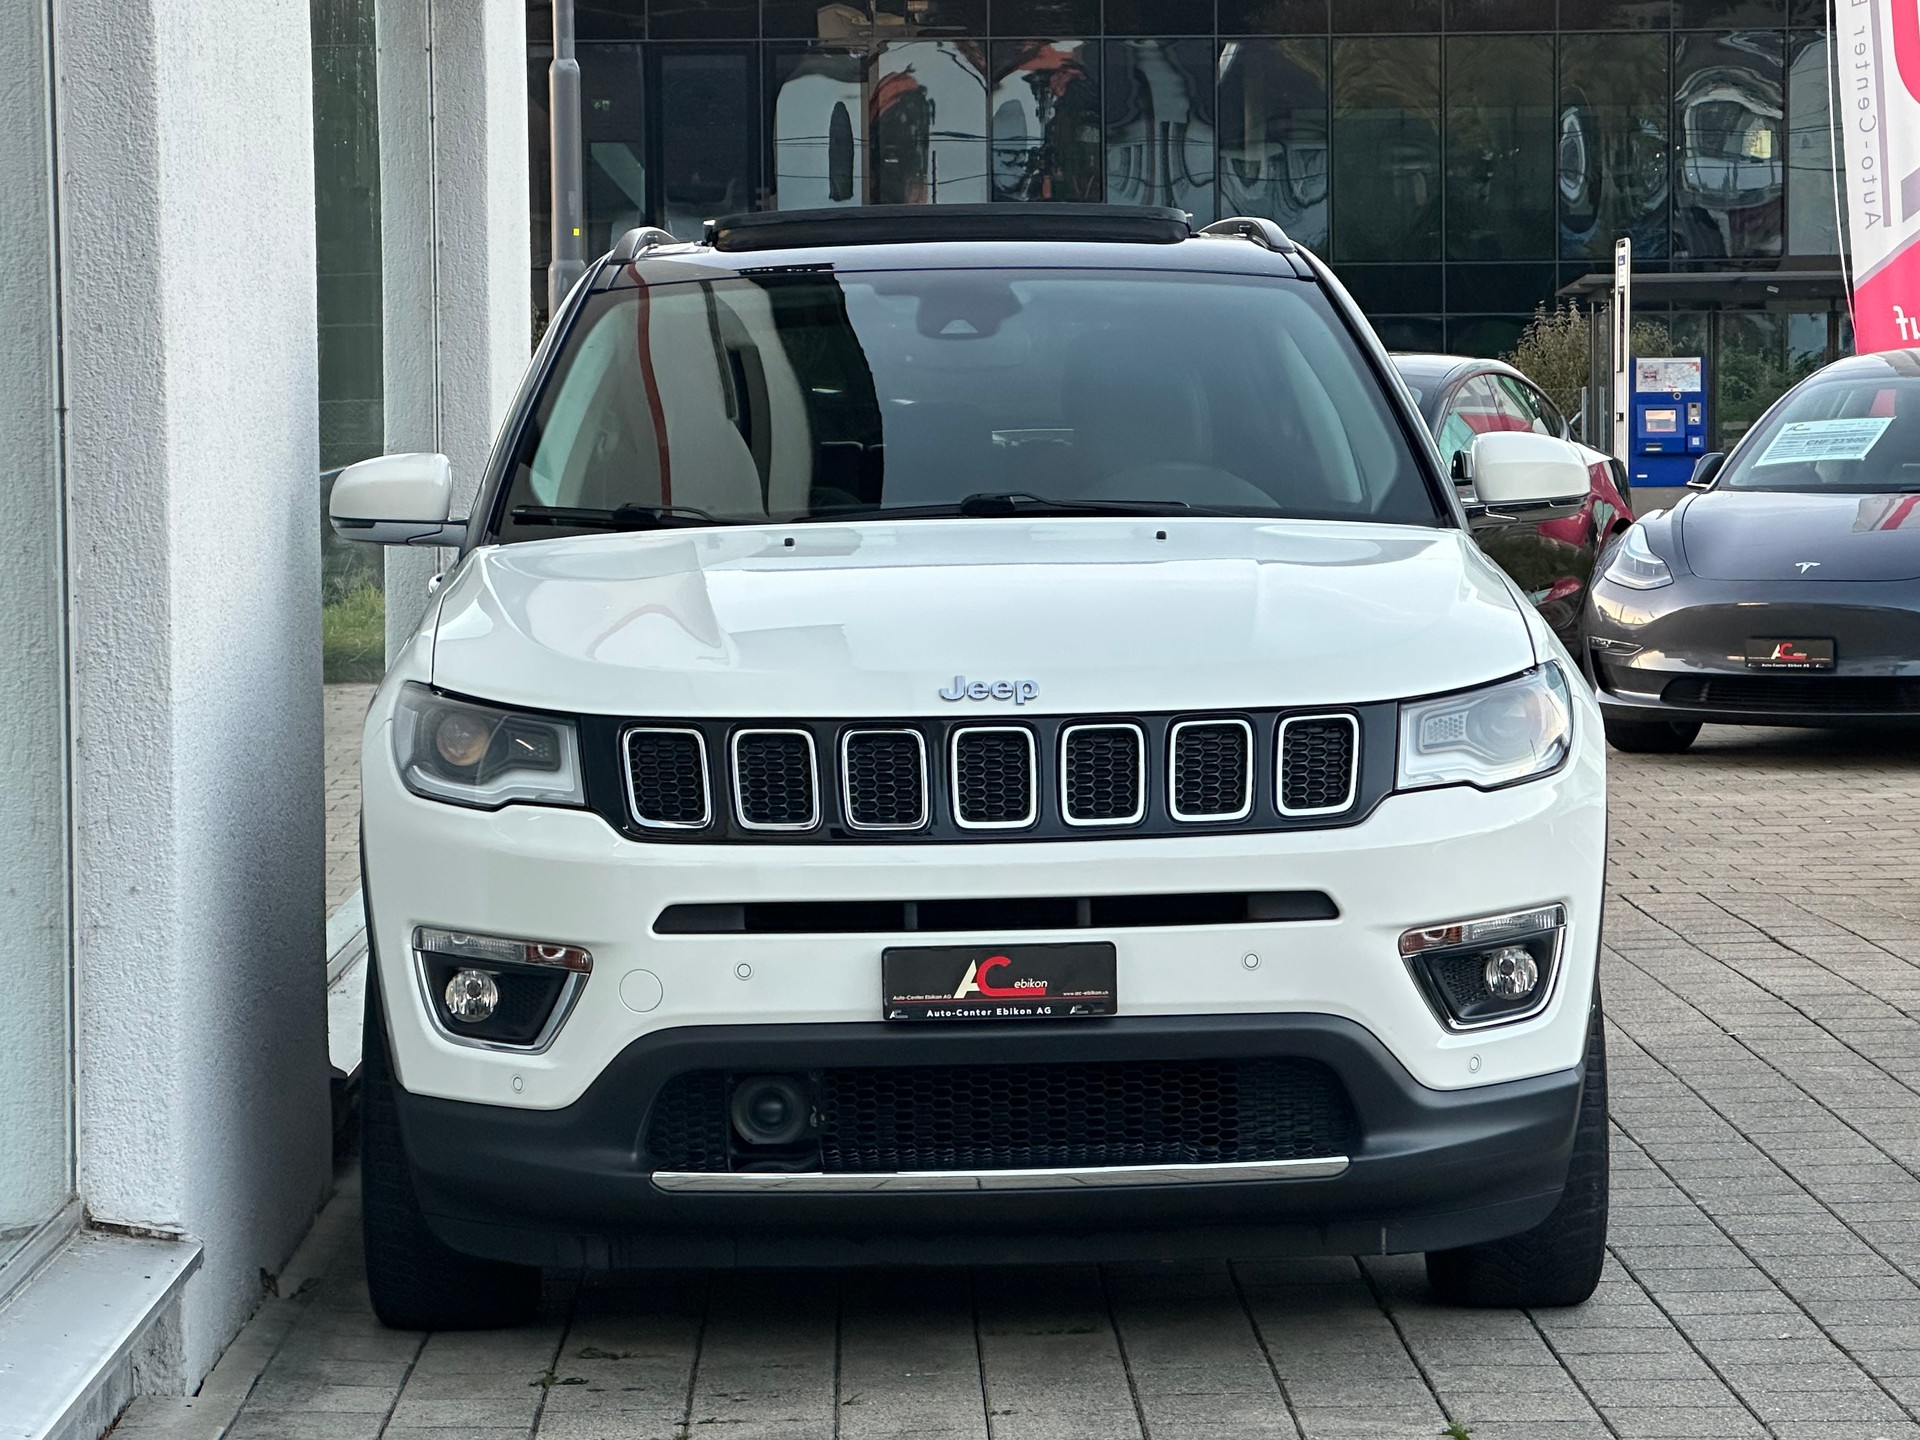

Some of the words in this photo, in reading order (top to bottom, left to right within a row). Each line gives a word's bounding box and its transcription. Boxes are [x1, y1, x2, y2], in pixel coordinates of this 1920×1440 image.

[939, 675, 1040, 705] Jeep
[953, 955, 1046, 998] AC
[1014, 978, 1048, 989] ebikon
[926, 1008, 992, 1018] Auto-Center
[996, 1007, 1032, 1016] Ebikon
[1036, 1006, 1052, 1015] AG
